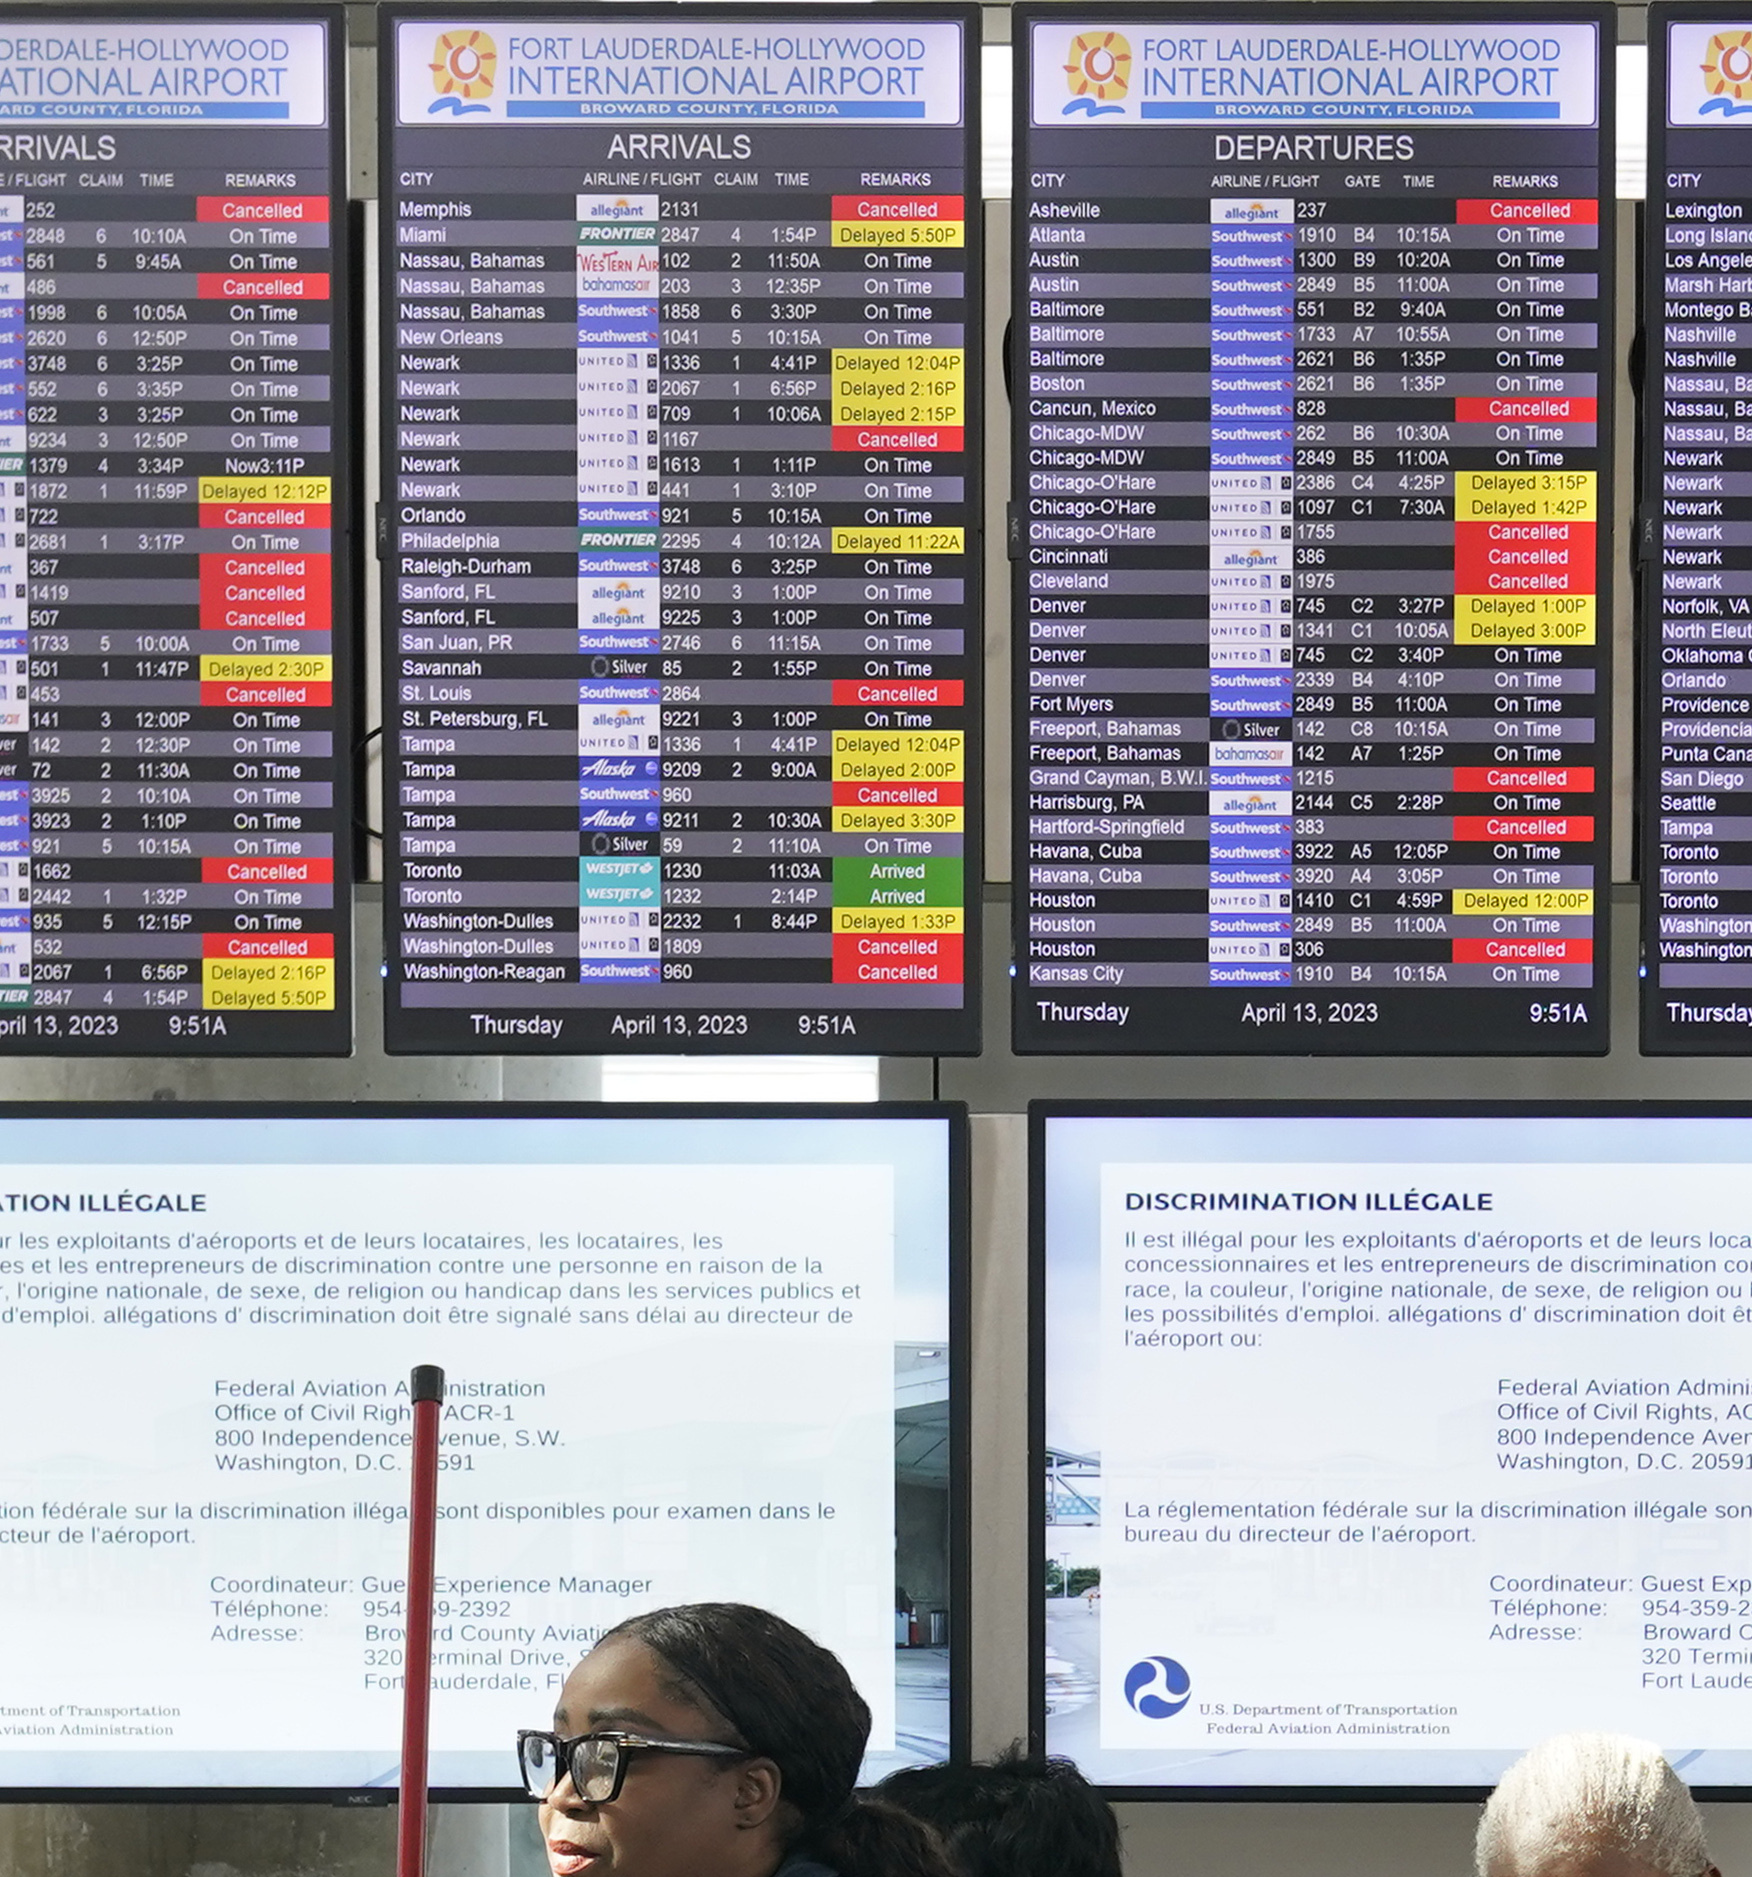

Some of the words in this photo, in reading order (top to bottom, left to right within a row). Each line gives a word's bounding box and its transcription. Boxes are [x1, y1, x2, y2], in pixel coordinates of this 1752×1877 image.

[510, 38, 572, 59] FORT
[582, 38, 925, 60] LAUDERDALE-HOLLYWOOD
[1145, 39, 1207, 61] FORT
[1217, 39, 1560, 61] LAUDERDALE-HOLLYWOOD
[149, 68, 287, 96] AIRPORT
[510, 66, 778, 95] INTERNATIONAL
[785, 67, 923, 95] AIRPORT
[1145, 67, 1413, 96] INTERNATIONAL
[1420, 68, 1559, 96] AIRPORT
[42, 104, 121, 116] COUNTY,
[127, 105, 203, 117] FLORIDA
[581, 103, 671, 114] BROWARD
[678, 104, 757, 116] COUNTY,
[763, 104, 838, 116] FLORIDA
[1216, 105, 1305, 115] BROWARD
[1312, 105, 1392, 117] COUNTY,
[1397, 105, 1473, 117] FLORIDA
[608, 134, 751, 159] ARRIVALS
[1216, 135, 1413, 160] DEPARTURES
[1666, 203, 1742, 221] Lexington
[1030, 696, 1062, 711] Fort
[1067, 696, 1113, 715] Myers
[1210, 697, 1281, 713] Southwest
[1296, 696, 1334, 711] 2849
[1352, 696, 1373, 711] B5
[1396, 696, 1447, 711] 11:00A
[1495, 697, 1518, 712] On
[1524, 697, 1561, 712] Time
[402, 761, 455, 780] Tampa
[581, 760, 642, 778] Alaska
[663, 762, 701, 777] 9209
[733, 762, 742, 777] 2
[772, 762, 817, 777] 9:00A
[842, 763, 904, 779] Delayed
[911, 763, 955, 777] 2:00P
[34, 989, 72, 1005] 2847
[103, 990, 113, 1005] 4
[144, 990, 188, 1005] 1:54P
[212, 991, 275, 1007] Delayed
[282, 991, 326, 1005] 5:50P
[1037, 1002, 1129, 1025] Thursday
[1242, 1003, 1285, 1026] April
[1294, 1003, 1321, 1024] 13,
[1329, 1003, 1378, 1022] 2023
[1530, 1003, 1587, 1022] 9:51A
[34, 1015, 62, 1037] 13,
[69, 1015, 118, 1035] 2023
[169, 1016, 226, 1035] 9:51A
[470, 1015, 563, 1038] Thursday
[611, 1015, 655, 1038] April
[663, 1015, 691, 1036] 13,
[698, 1015, 747, 1034] 2023
[799, 1015, 856, 1034] 9:51A
[80, 1189, 206, 1212] ILLÉGALE
[1126, 1193, 1356, 1210] DISCRIMINATION
[1366, 1188, 1492, 1211] ILLÉGALE
[1499, 1379, 1577, 1395] Federal
[1586, 1379, 1669, 1396] Aviation
[1498, 1403, 1558, 1420] Office
[1567, 1403, 1586, 1420] of
[1594, 1403, 1637, 1420] Civil
[1647, 1403, 1717, 1424] Rights,
[1498, 1429, 1536, 1445] 800
[1545, 1428, 1694, 1449] Independence
[1497, 1453, 1628, 1474] Washington,
[1638, 1453, 1682, 1469] D.C.
[1490, 1599, 1606, 1620] Téléphone:
[1200, 1704, 1228, 1715] U.S.
[1234, 1704, 1322, 1717] Department
[1326, 1704, 1341, 1715] of
[1344, 1704, 1457, 1717] Transportation
